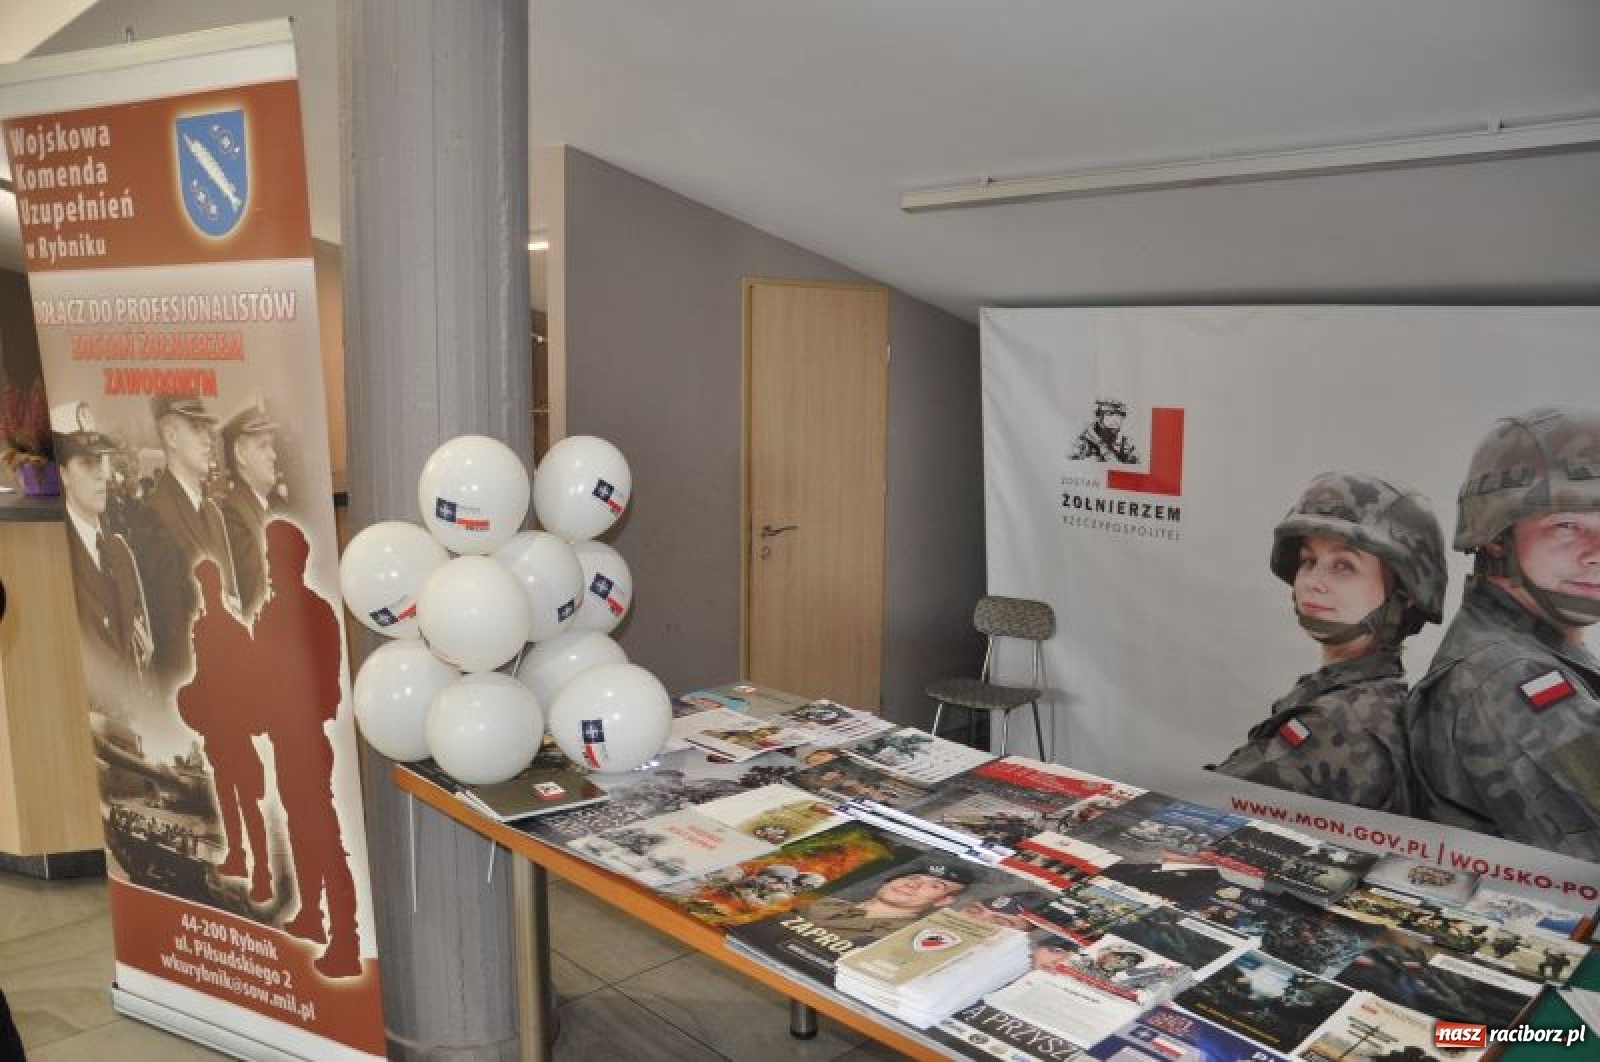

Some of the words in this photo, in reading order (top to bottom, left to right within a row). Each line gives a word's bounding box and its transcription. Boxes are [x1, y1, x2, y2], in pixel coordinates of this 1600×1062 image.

[10, 122, 111, 161] Wojskowa
[16, 155, 108, 191] Komenda
[38, 233, 107, 264] Rybniku
[89, 299, 111, 323] DO
[116, 287, 296, 323] PROFESJONALISTÓW
[181, 913, 227, 943] 44-200
[229, 927, 279, 961] Rybnik
[174, 934, 193, 955] ul.
[282, 969, 293, 989] 2
